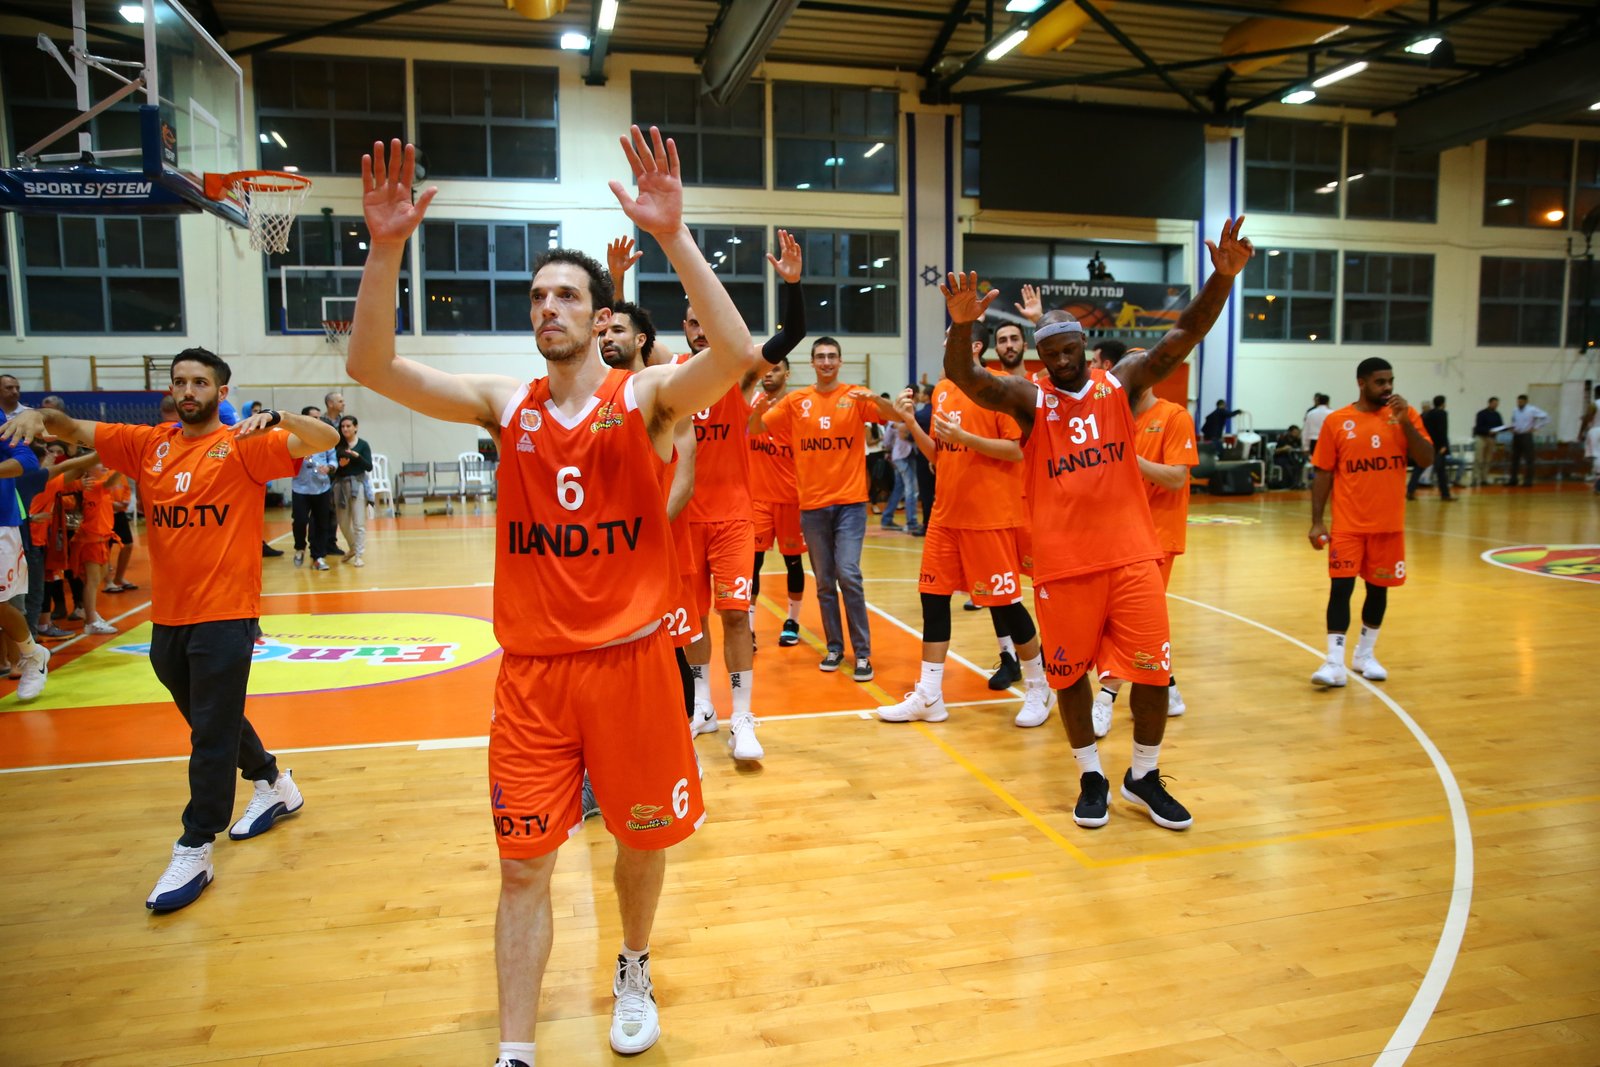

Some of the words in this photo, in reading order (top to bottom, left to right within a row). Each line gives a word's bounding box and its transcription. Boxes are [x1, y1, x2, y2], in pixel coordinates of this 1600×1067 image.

[24, 182, 81, 195] SPORT
[84, 182, 152, 198] SYSTEM
[1041, 282, 1088, 297] טלוויזיה
[1091, 286, 1124, 298] עמדת
[818, 416, 831, 430] 15
[1068, 413, 1099, 445] 31
[801, 437, 854, 451] ILAND.TV
[1371, 434, 1381, 449] 8
[1047, 441, 1125, 479] ILAND.TV
[174, 471, 192, 493] 10
[556, 465, 585, 511] 6
[508, 516, 643, 558] ILAND.TV
[1394, 560, 1406, 579] 8
[991, 571, 1017, 596] 25
[662, 607, 691, 635] 22
[672, 777, 689, 819] 6
